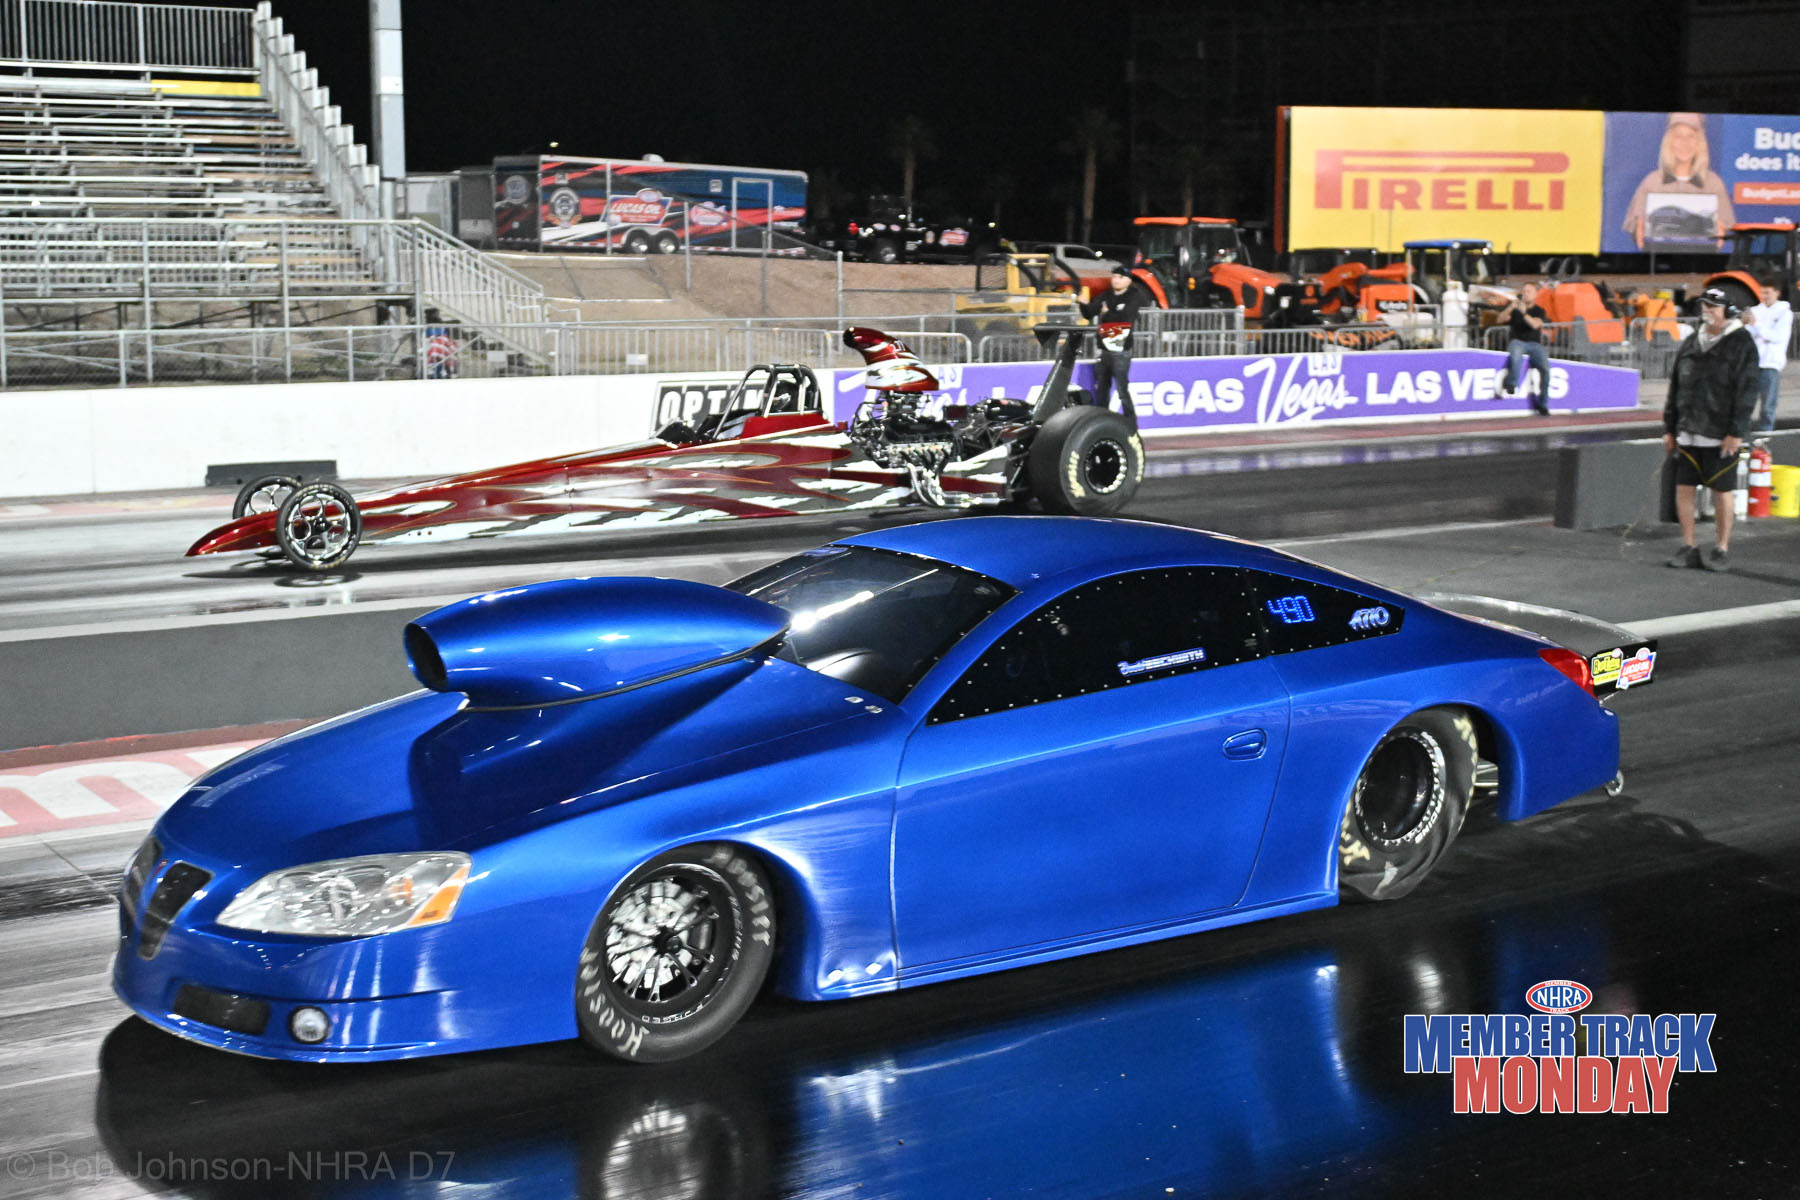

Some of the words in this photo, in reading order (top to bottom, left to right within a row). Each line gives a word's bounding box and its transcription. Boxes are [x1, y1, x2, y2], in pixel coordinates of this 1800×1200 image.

[1314, 150, 1570, 210] PIRELLI
[1735, 153, 1782, 171] does
[1243, 357, 1358, 423] Vegas
[1366, 371, 1442, 405] LAS
[1267, 595, 1315, 623] 490
